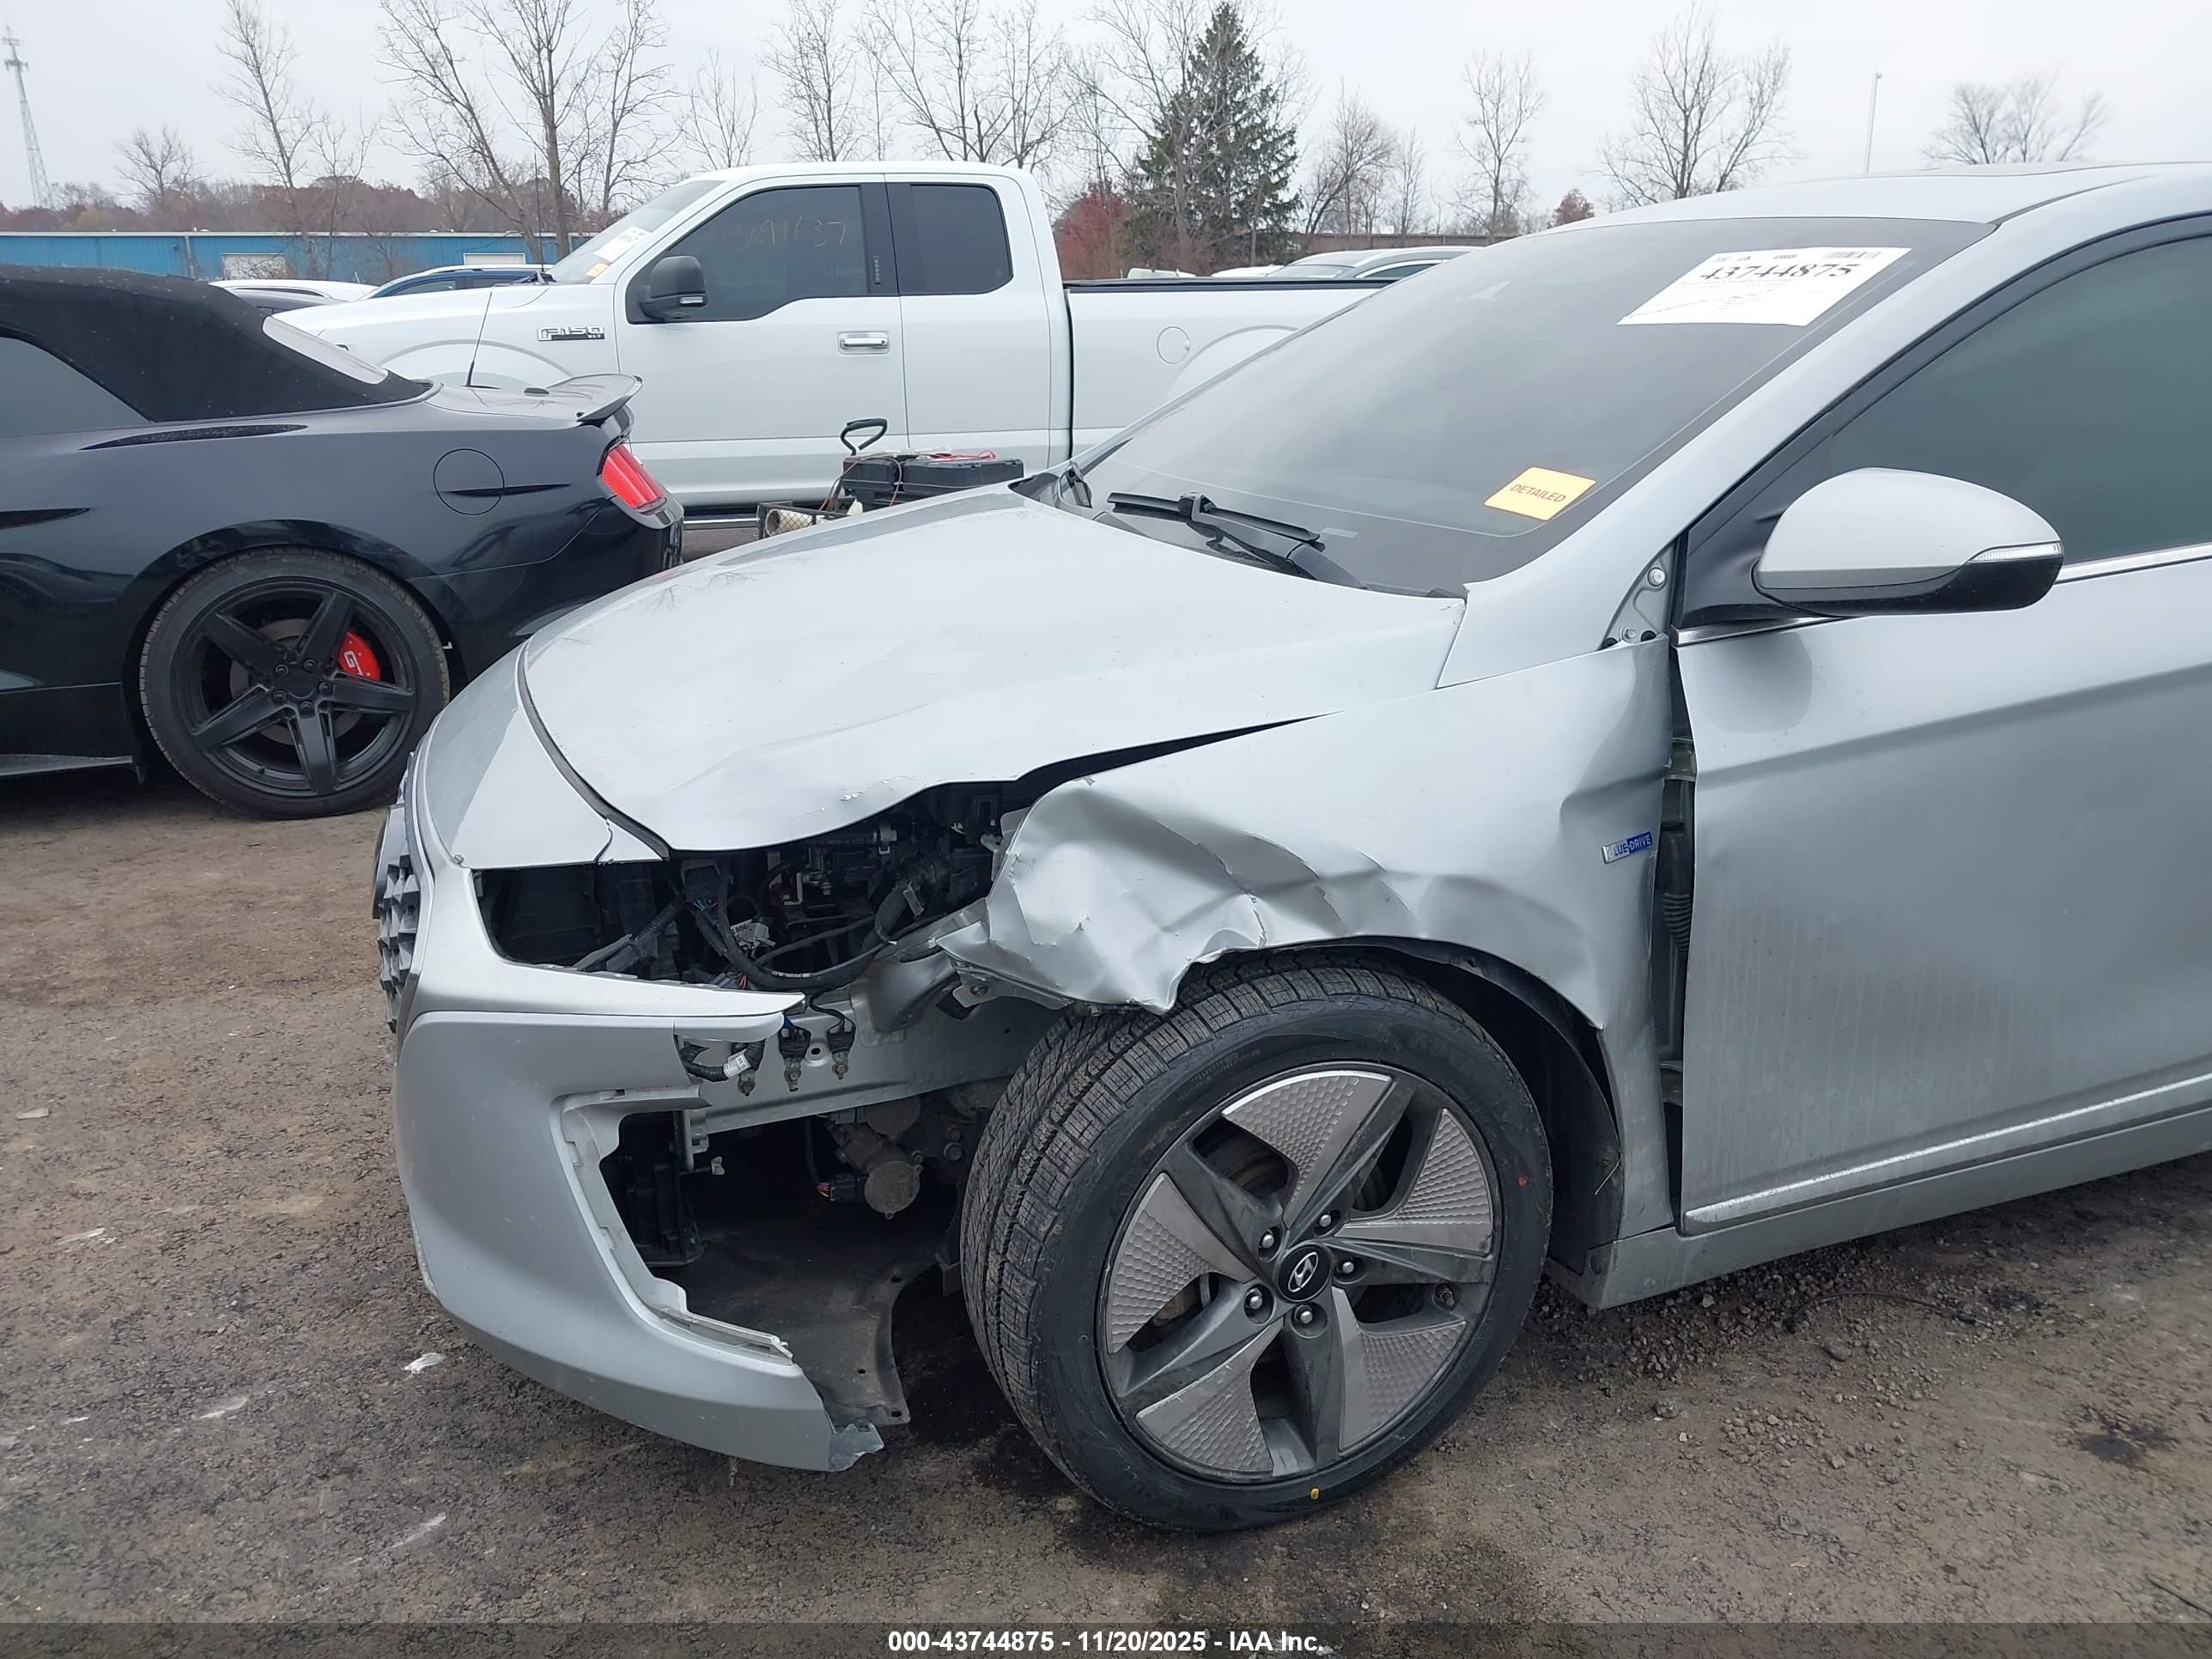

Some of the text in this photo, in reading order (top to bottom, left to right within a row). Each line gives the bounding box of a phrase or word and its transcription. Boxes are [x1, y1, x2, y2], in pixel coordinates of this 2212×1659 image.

[1699, 264, 1861, 280] 43744875
[1510, 483, 1566, 502] DETAILED
[1607, 834, 1652, 857] LUE-DRIVE
